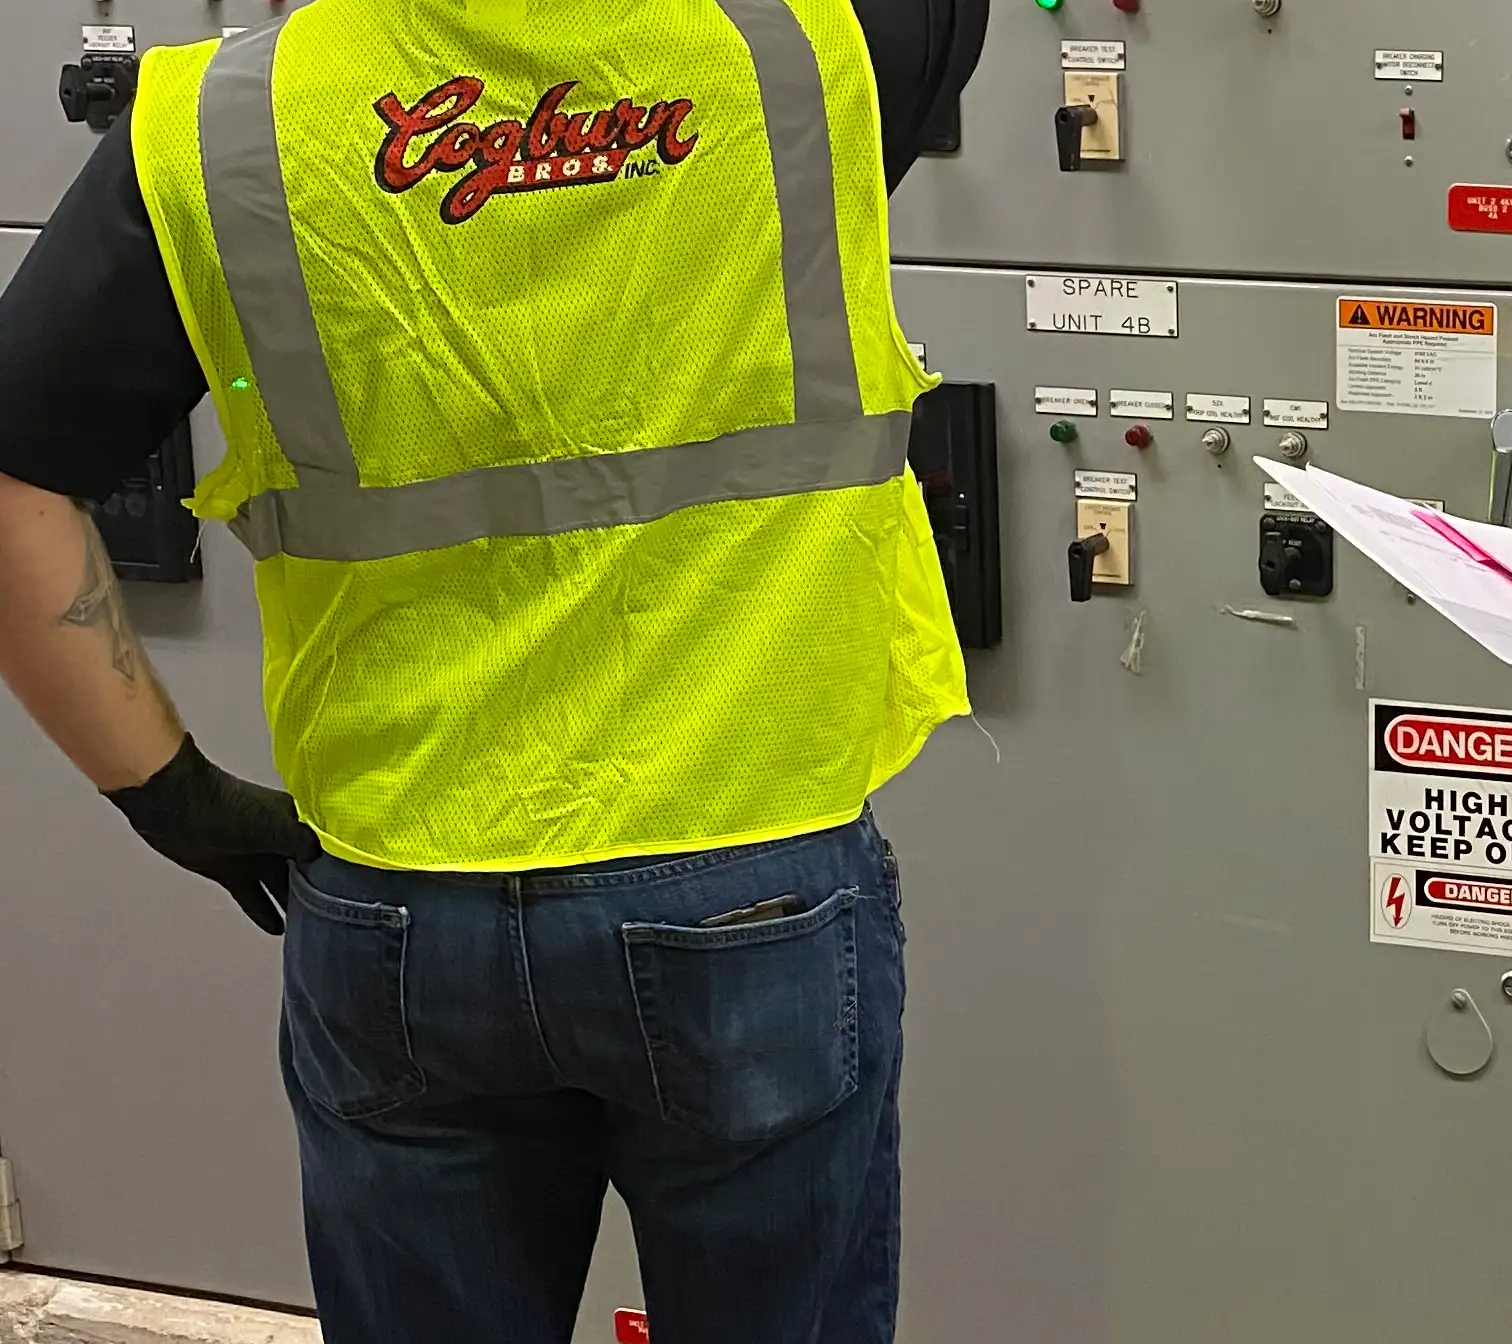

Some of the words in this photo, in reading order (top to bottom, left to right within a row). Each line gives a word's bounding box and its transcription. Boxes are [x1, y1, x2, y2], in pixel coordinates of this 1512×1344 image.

[372, 74, 699, 226] Cogburn
[1062, 278, 1139, 298] SPARE
[1052, 313, 1103, 331] UNIT
[1121, 316, 1151, 334] 4B
[1376, 305, 1485, 331] WARNING
[1424, 787, 1508, 817] HIGH
[1380, 832, 1473, 861] KEEP
